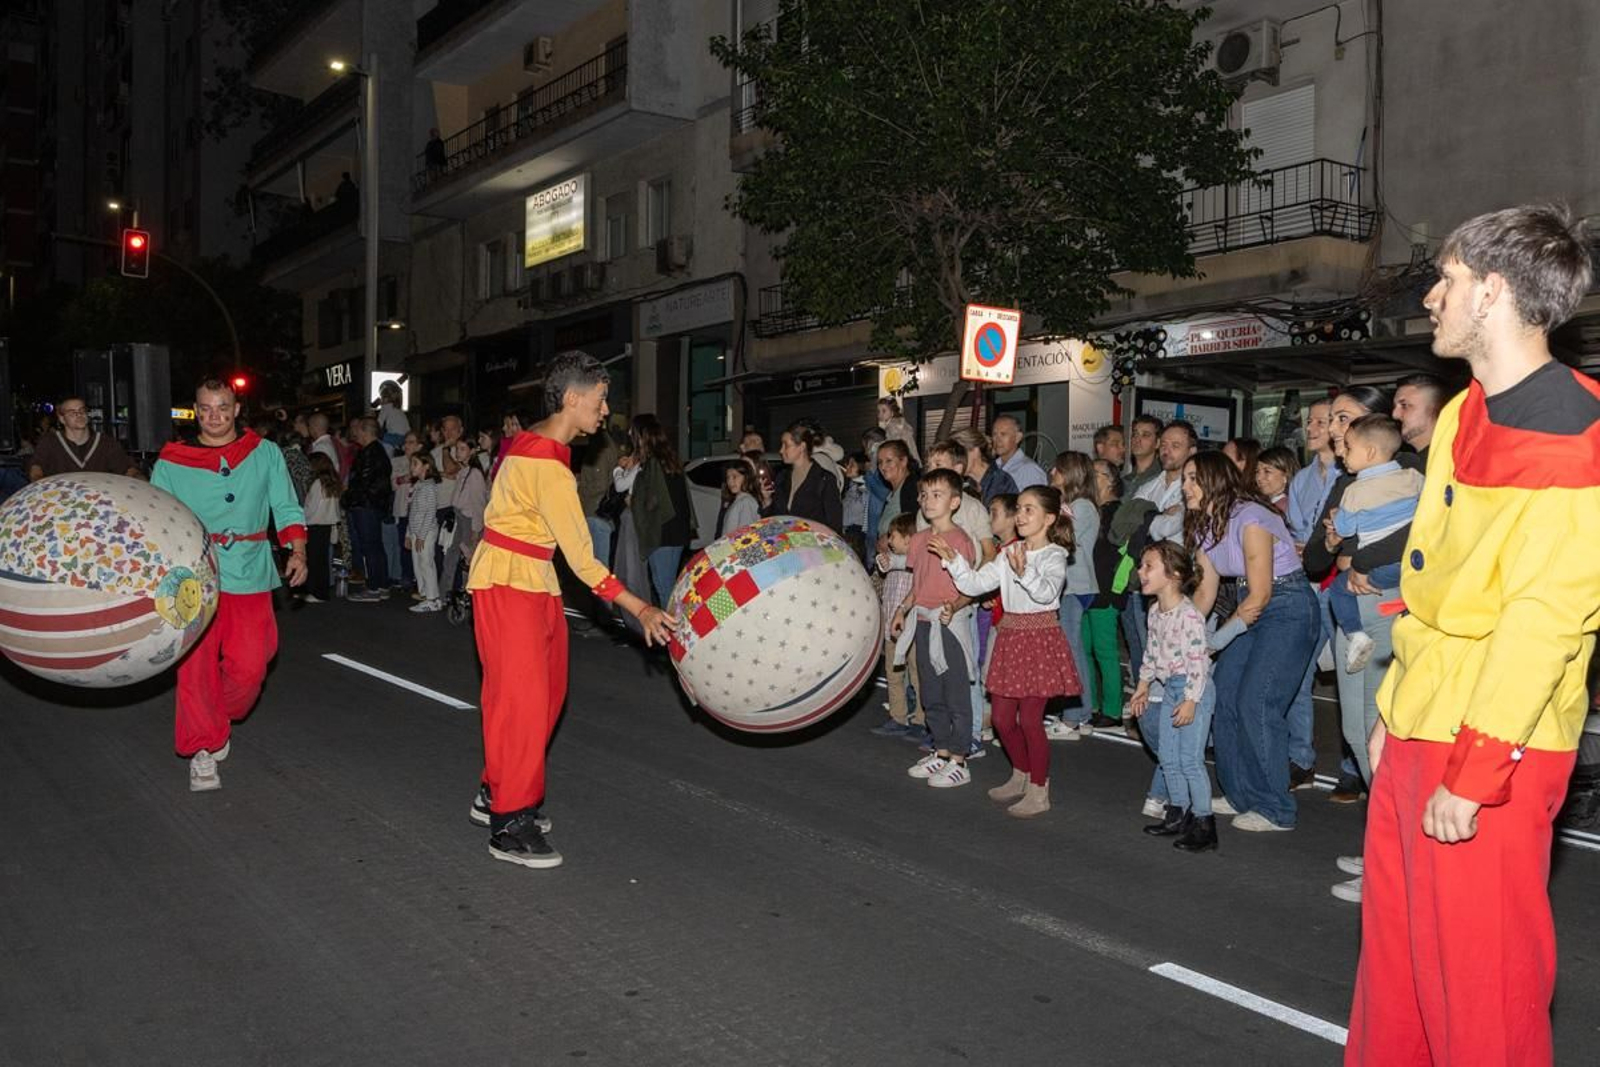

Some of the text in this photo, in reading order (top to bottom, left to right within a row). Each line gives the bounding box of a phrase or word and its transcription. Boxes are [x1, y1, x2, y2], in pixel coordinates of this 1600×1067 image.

[532, 179, 578, 210] ABOGADO
[1190, 337, 1262, 355] BARBER SHOP
[325, 362, 353, 388] VERA
